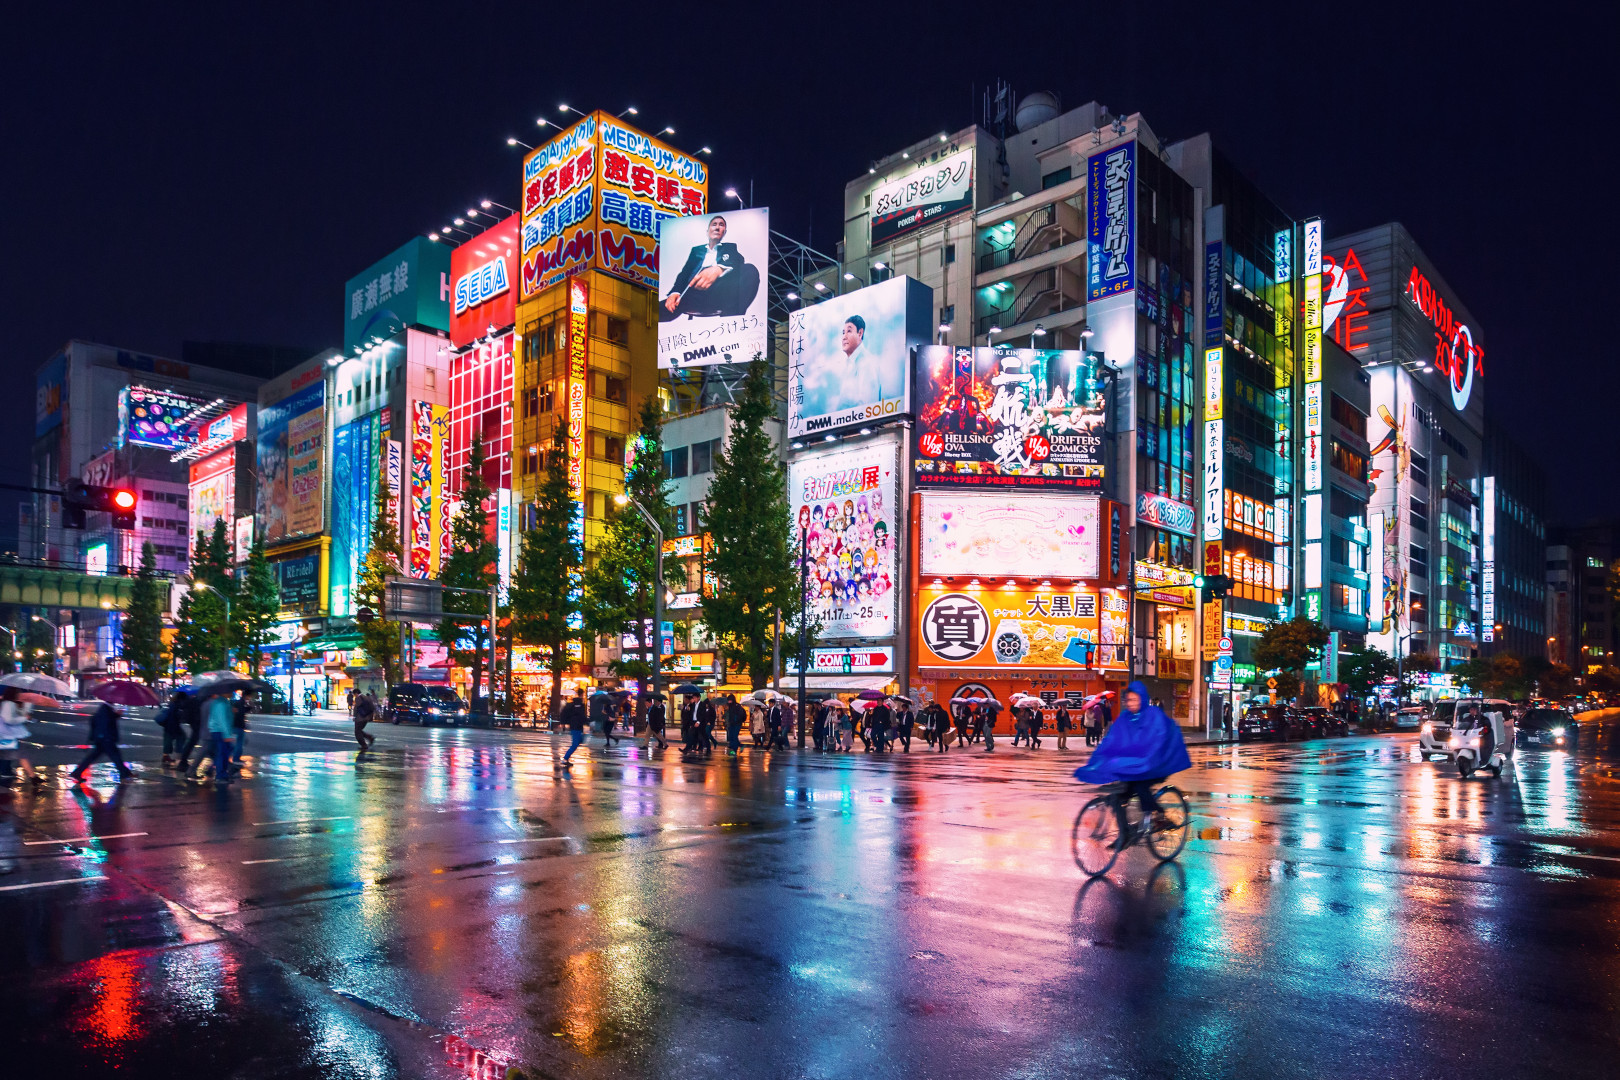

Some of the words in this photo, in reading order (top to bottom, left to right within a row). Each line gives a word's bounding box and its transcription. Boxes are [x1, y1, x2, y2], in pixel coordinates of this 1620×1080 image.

[603, 122, 706, 184] MEDIAリサイクル
[525, 146, 596, 215] 激安販売
[604, 149, 704, 217] 激安販売
[876, 162, 967, 215] メイドカジノ
[523, 182, 594, 256] 高額買取
[897, 214, 916, 229] POKER
[923, 204, 943, 219] STARS
[522, 229, 596, 295] Mulan
[611, 264, 643, 281] ムーラン
[456, 258, 509, 314] SEGA
[658, 314, 765, 354] 冒険しつづけよう。
[1306, 332, 1317, 378] Submarine
[789, 311, 806, 437] 次は太陽か。
[865, 398, 901, 419] solar
[944, 433, 994, 445] HELLSING
[944, 442, 966, 452] OVA
[1050, 434, 1101, 446] DRIFTERS
[1050, 444, 1089, 453] COMICS
[1089, 445, 1097, 454] 6
[389, 443, 400, 483] AKKY
[1019, 477, 1044, 486] SCARS
[1137, 495, 1195, 531] メイドカジノ
[993, 608, 1024, 618] チケット
[1026, 594, 1096, 619] 大黒屋
[931, 604, 981, 652] 質
[1220, 640, 1230, 649] 40
[855, 654, 871, 666] ZIN
[1030, 680, 1069, 689] チケット
[1022, 691, 1084, 711] 黒屋
